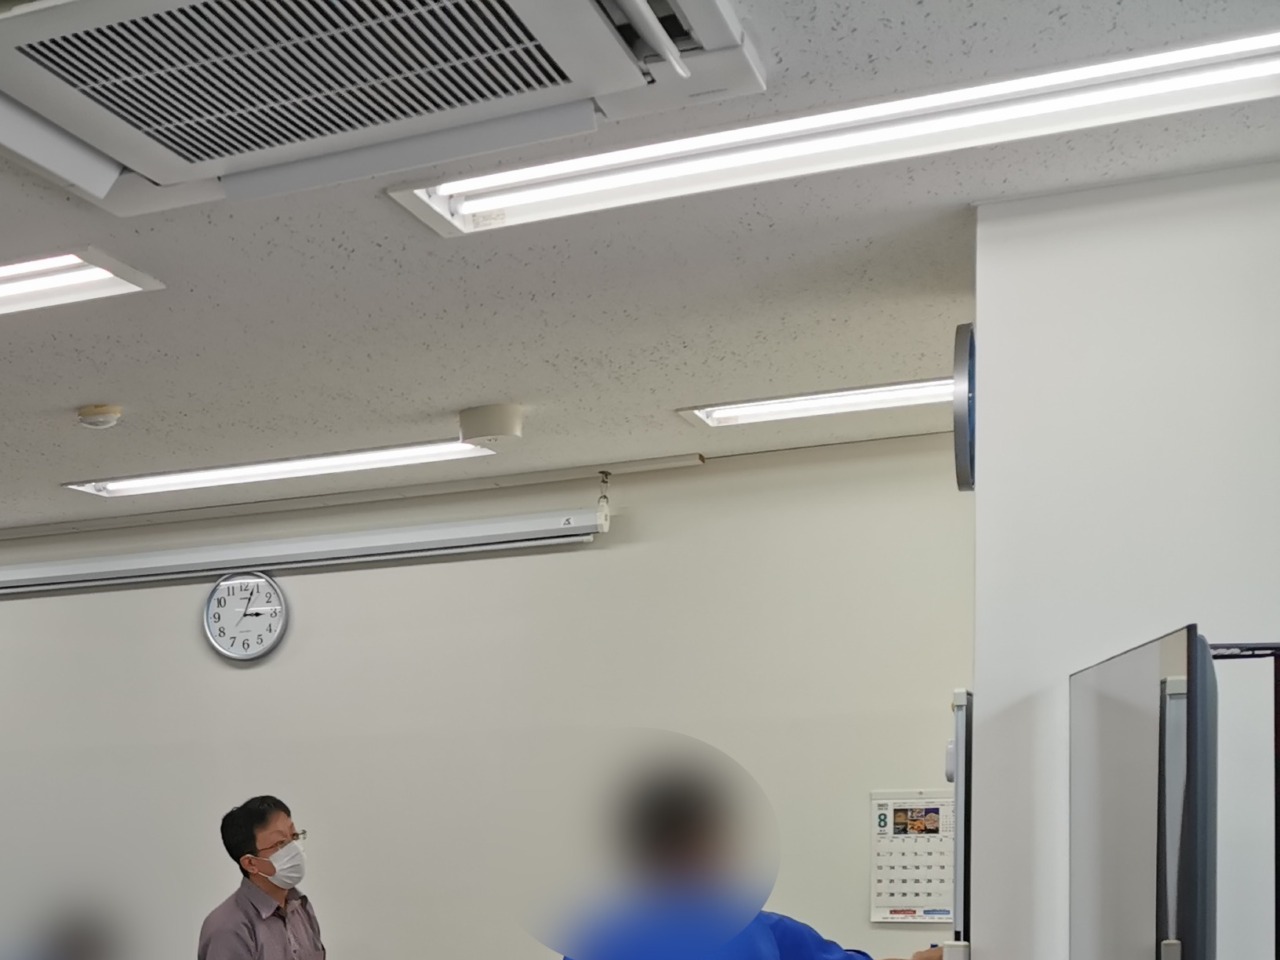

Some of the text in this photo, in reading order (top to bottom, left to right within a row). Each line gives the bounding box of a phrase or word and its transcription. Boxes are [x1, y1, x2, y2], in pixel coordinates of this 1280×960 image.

[227, 586, 235, 596] 11
[216, 597, 226, 608] 10
[265, 592, 272, 603] 2
[213, 612, 221, 623] 9
[270, 608, 277, 618] 3
[218, 627, 226, 637] 8
[266, 623, 272, 633] 4
[229, 637, 236, 647] 7
[242, 639, 250, 650] 6
[256, 634, 263, 645] 5
[878, 813, 887, 828] 8
